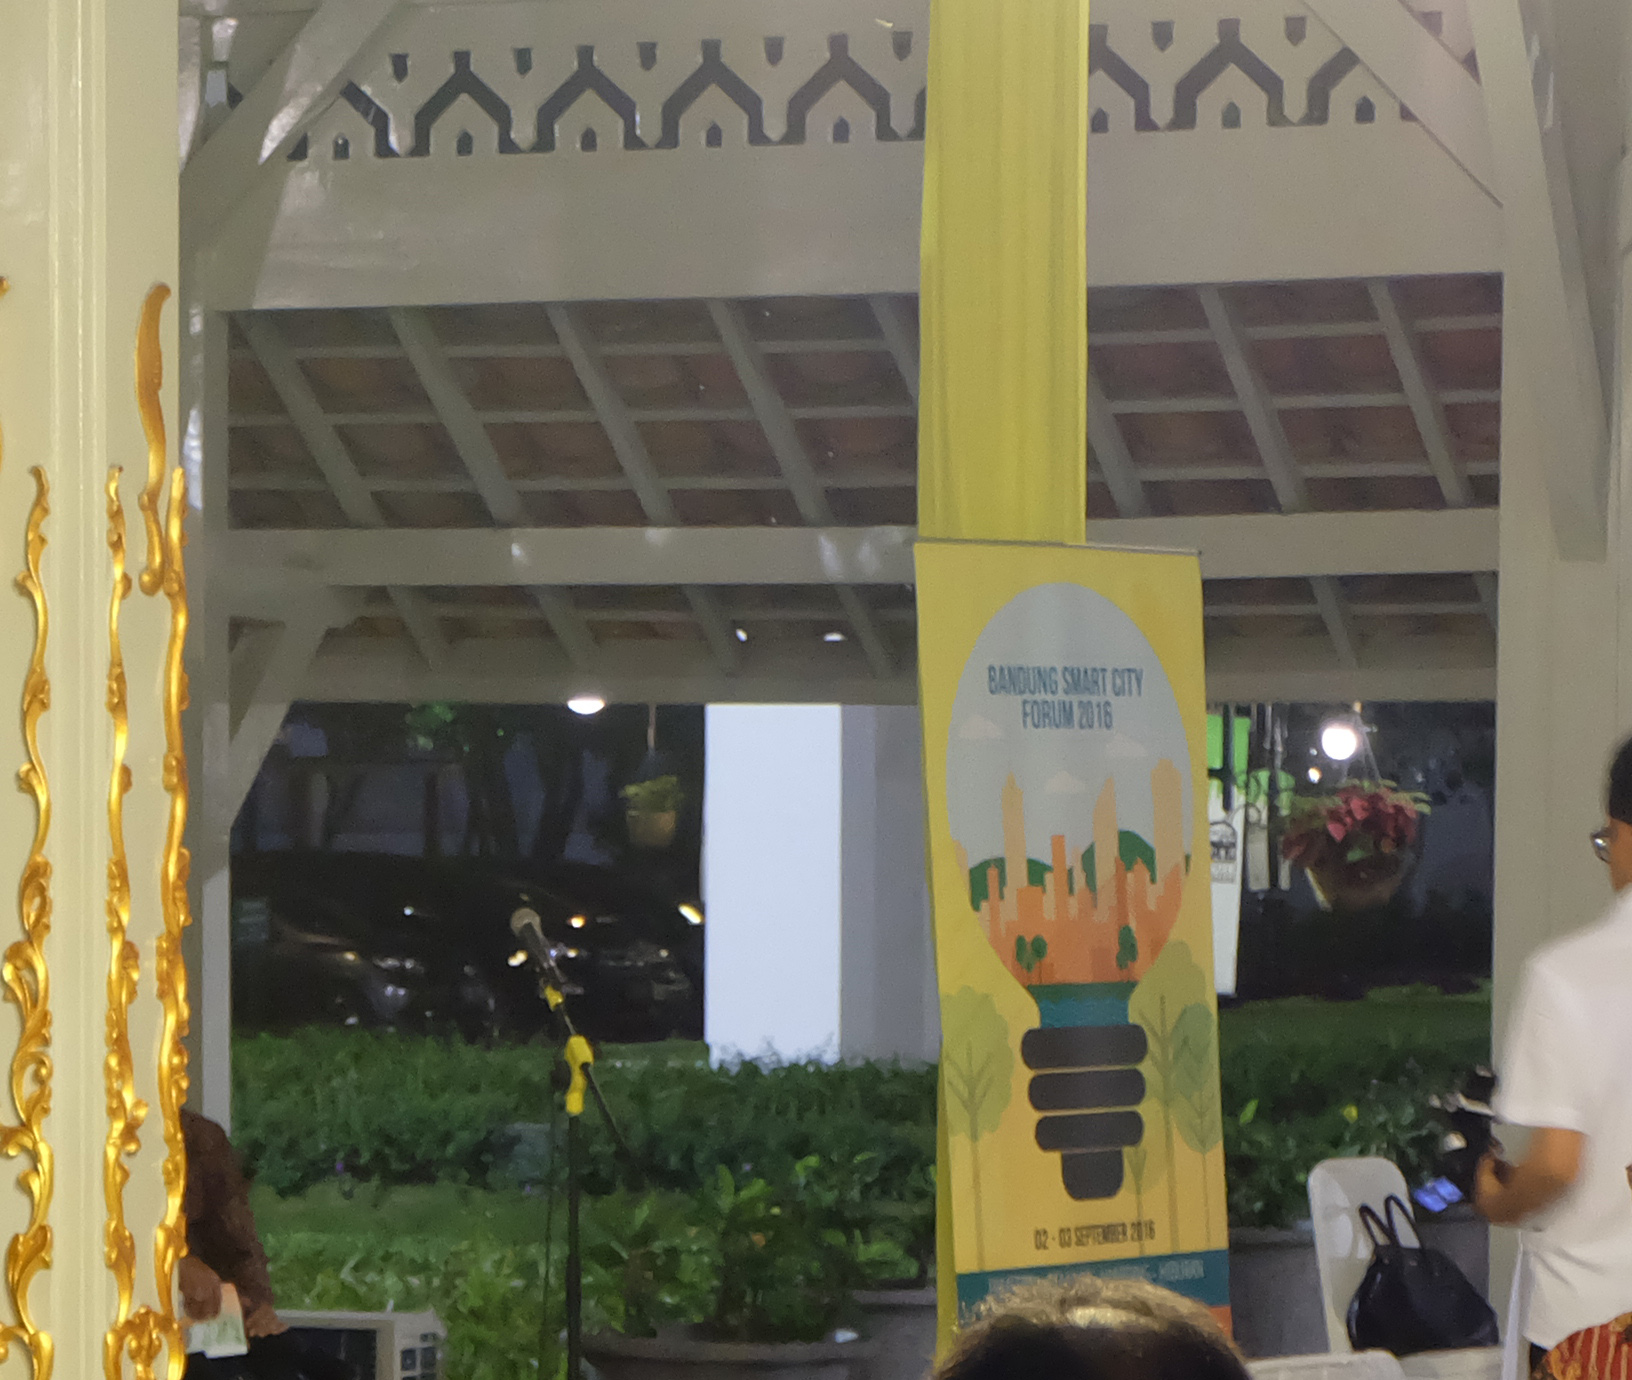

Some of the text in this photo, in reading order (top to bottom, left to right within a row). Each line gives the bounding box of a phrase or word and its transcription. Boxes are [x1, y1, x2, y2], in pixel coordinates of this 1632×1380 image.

[988, 664, 1144, 697] BANDUNG SMART CITY
[1022, 699, 1114, 730] FORUM 2016
[1034, 1228, 1049, 1250] 02
